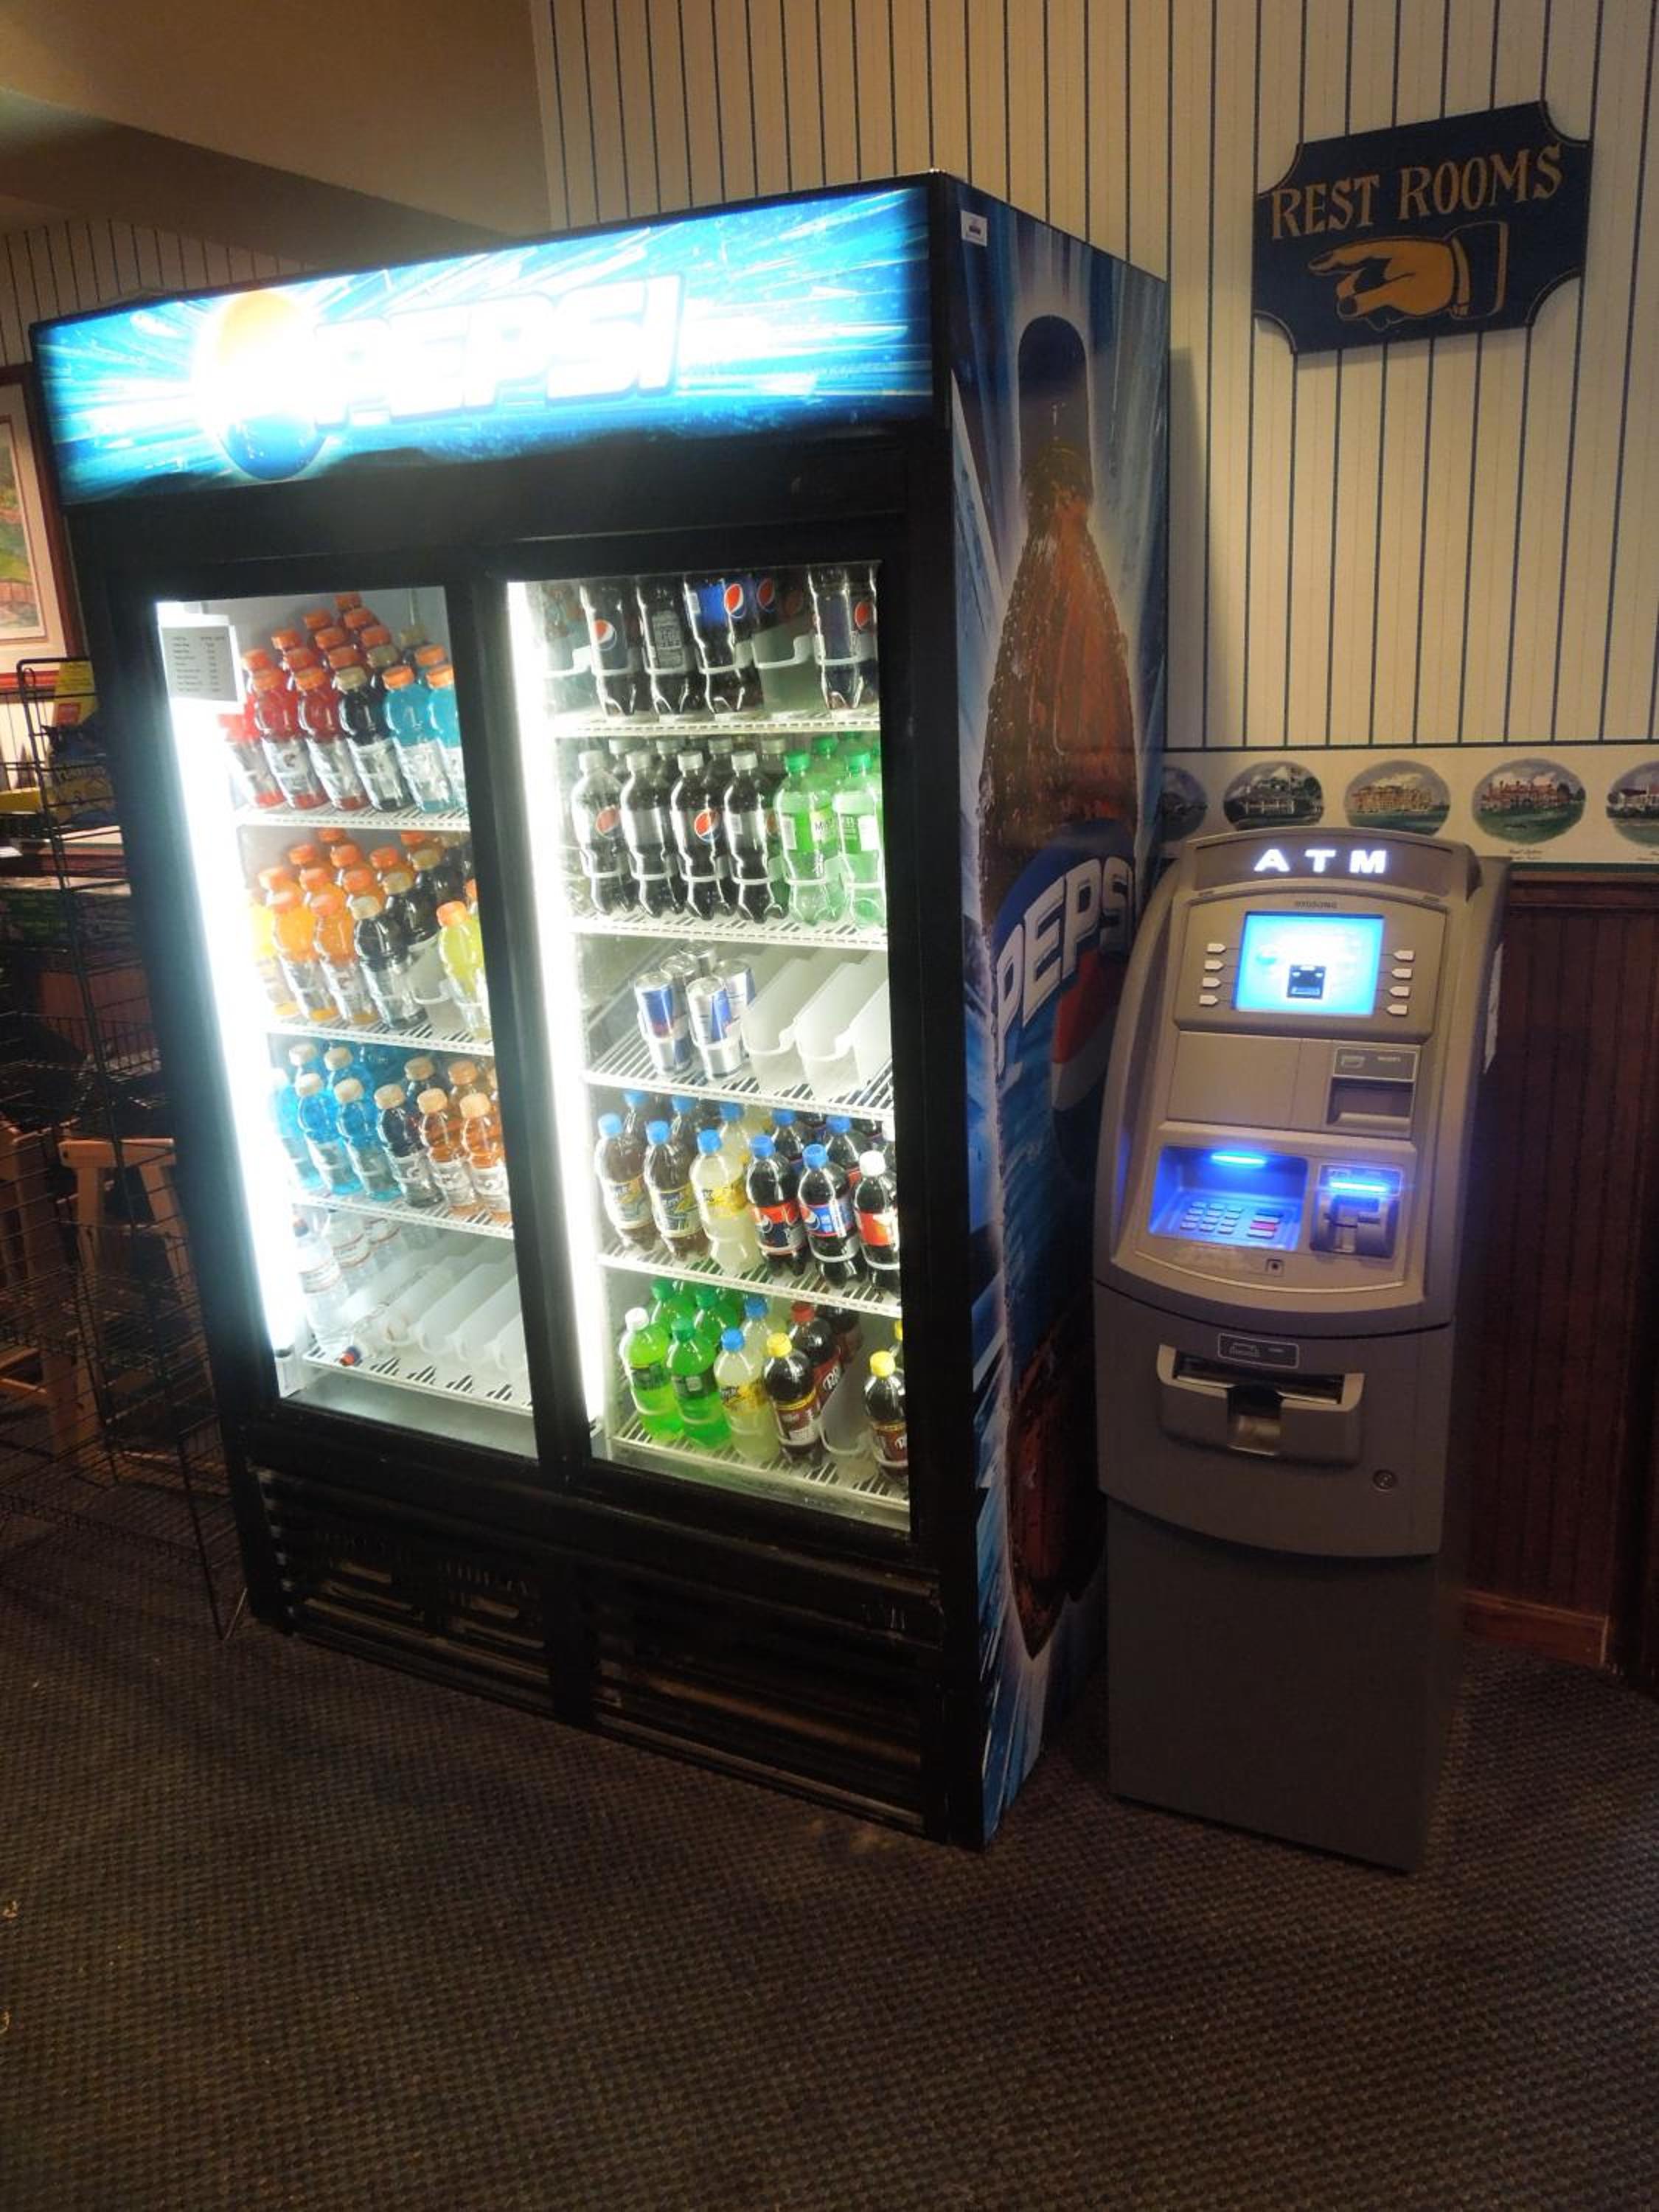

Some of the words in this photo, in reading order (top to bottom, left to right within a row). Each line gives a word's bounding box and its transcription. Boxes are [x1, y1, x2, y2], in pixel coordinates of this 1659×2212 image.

[1271, 173, 1380, 241] REST
[1397, 142, 1564, 220] ROOMS
[314, 273, 683, 428] PEPSI
[1253, 848, 1388, 874] ATM
[996, 856, 1134, 1077] PEPS
